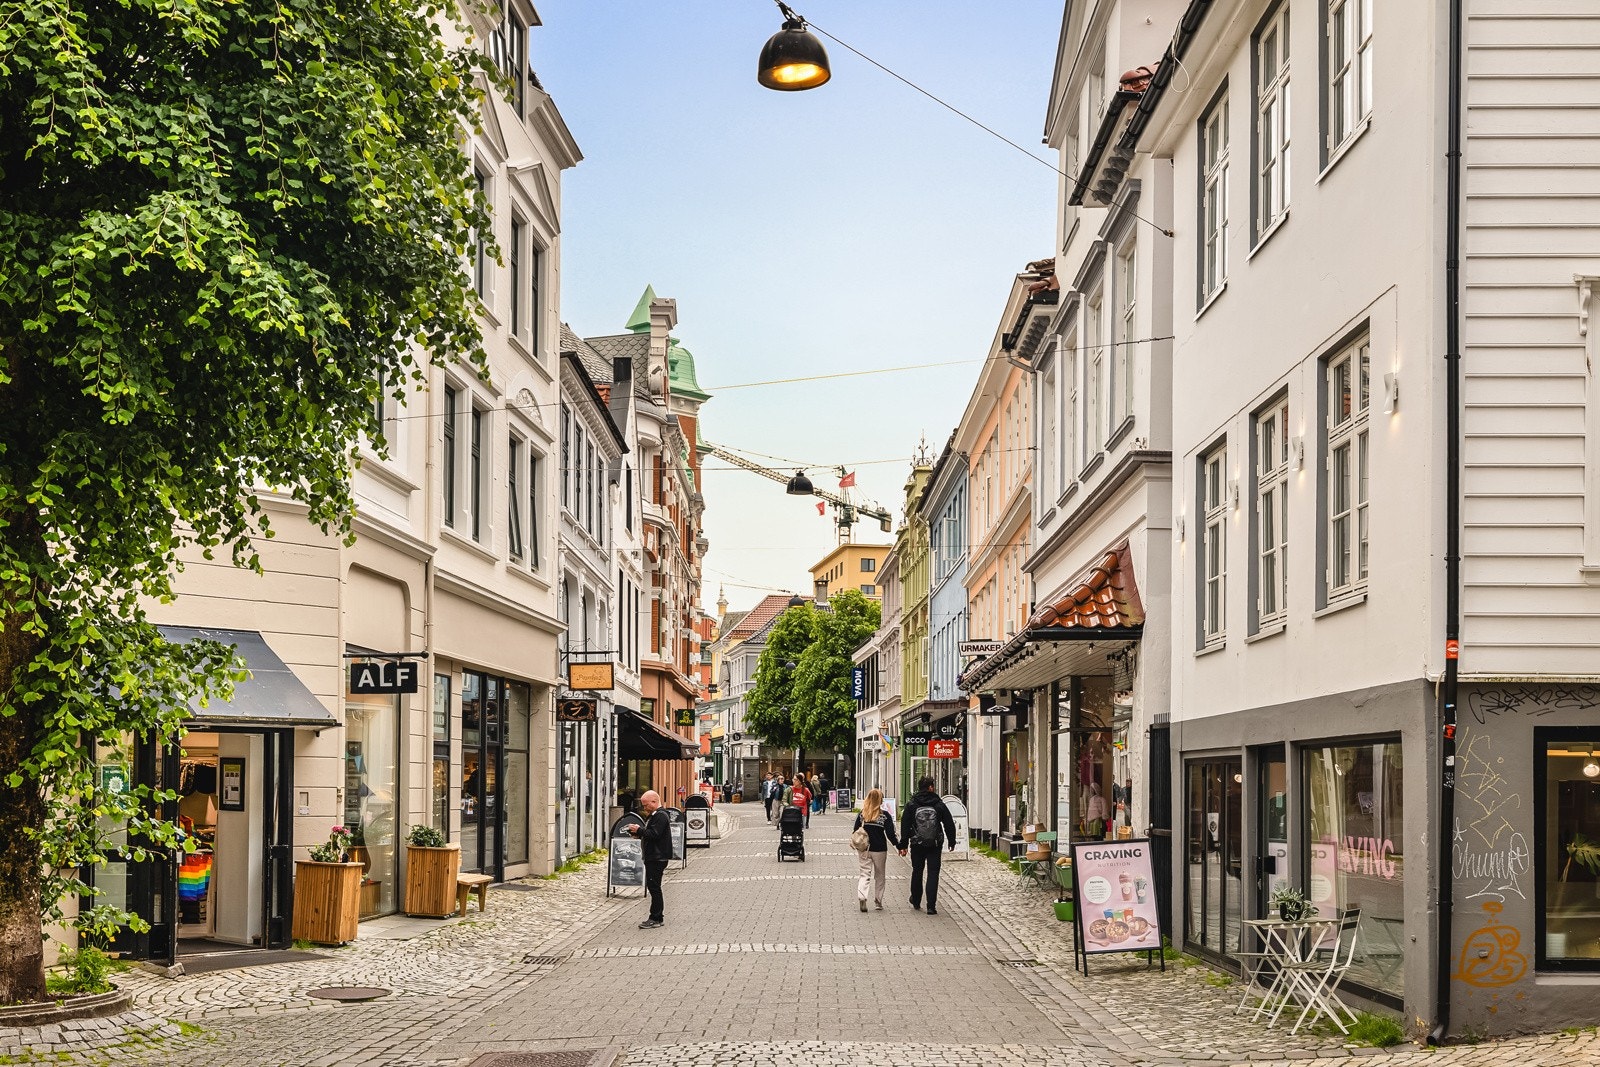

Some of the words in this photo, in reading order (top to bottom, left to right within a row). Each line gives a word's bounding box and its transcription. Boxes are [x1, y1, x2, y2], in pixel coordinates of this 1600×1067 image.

[358, 665, 402, 687] ALF
[854, 671, 862, 697] MOVA
[941, 725, 957, 735] city
[1084, 849, 1142, 860] CRAVING
